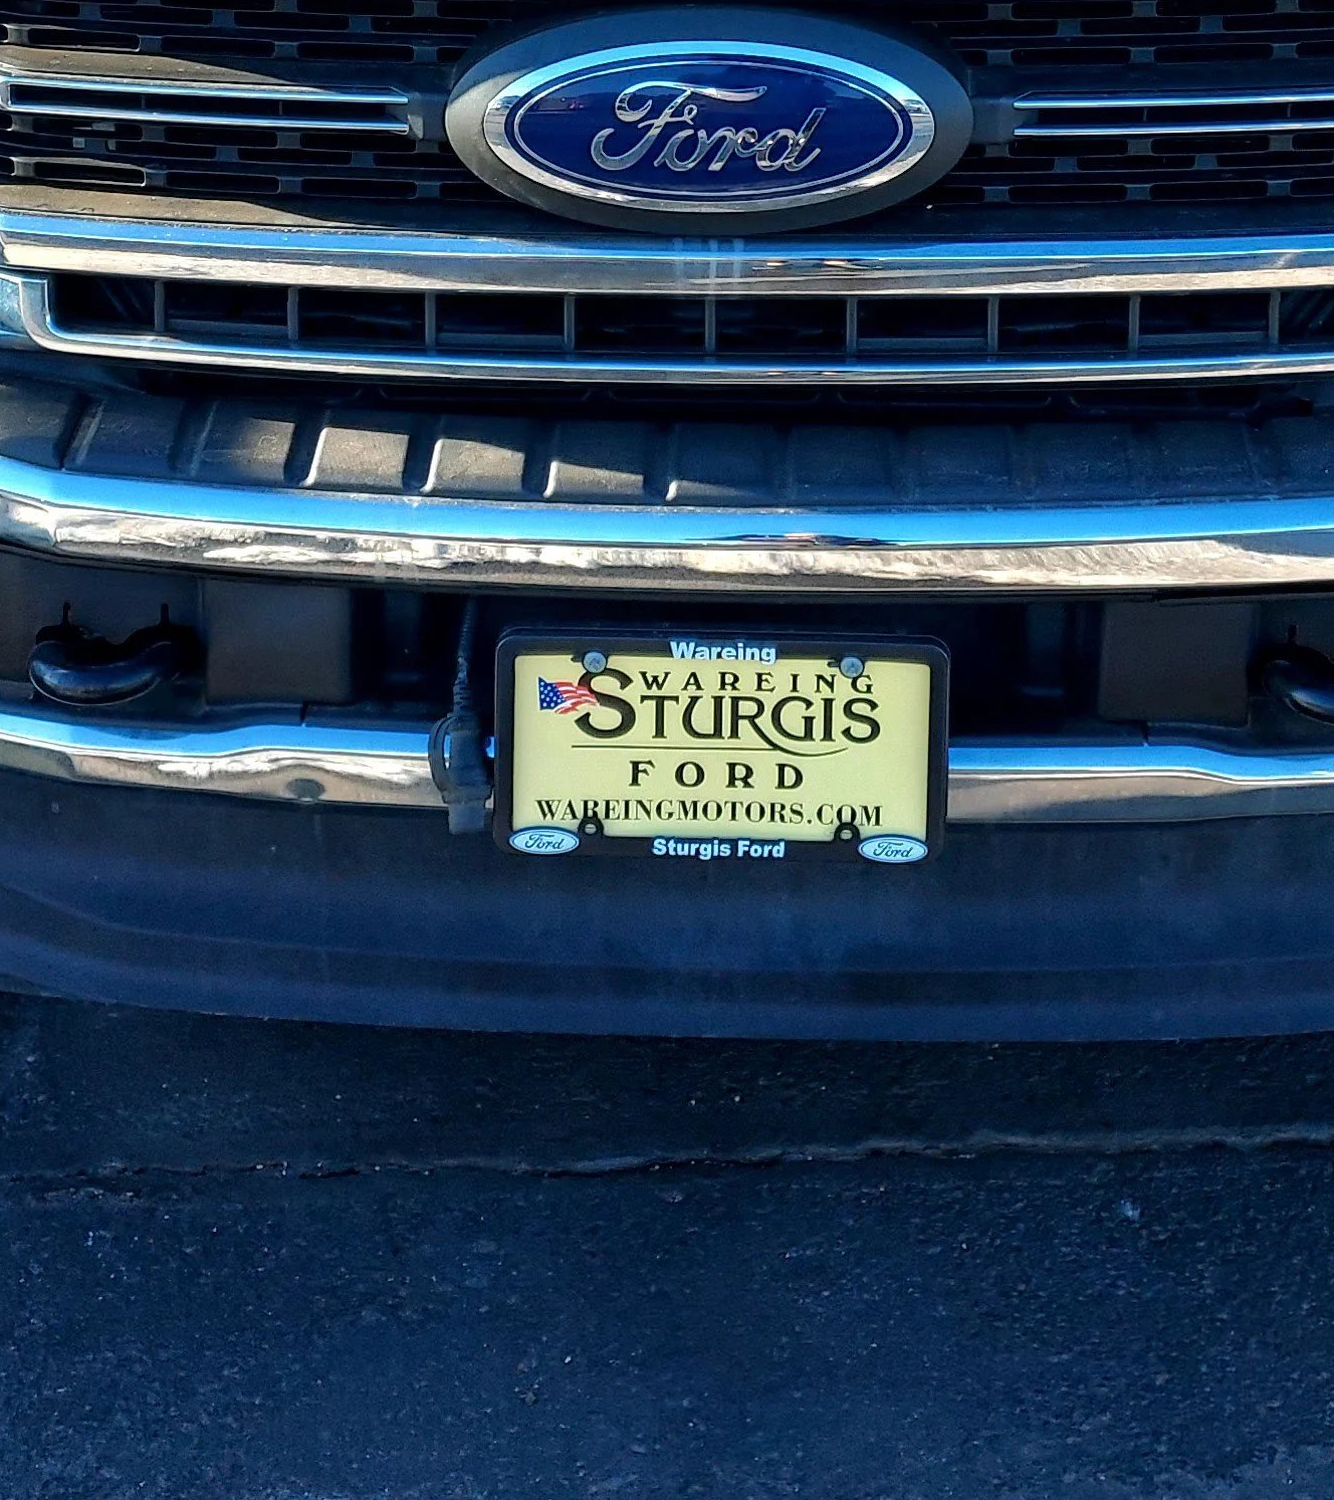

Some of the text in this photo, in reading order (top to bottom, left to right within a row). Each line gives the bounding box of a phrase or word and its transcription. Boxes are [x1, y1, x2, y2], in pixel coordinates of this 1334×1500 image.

[590, 80, 827, 172] Ford
[669, 641, 777, 666] Wareing
[638, 671, 874, 694] WAREING
[574, 667, 881, 746] STURGIS
[628, 759, 804, 790] FORD
[535, 799, 883, 827] WAREINGMOTORS.COM
[524, 833, 565, 851] Ford
[652, 838, 786, 861] Sturgis Ford
[872, 841, 914, 859] Ford
